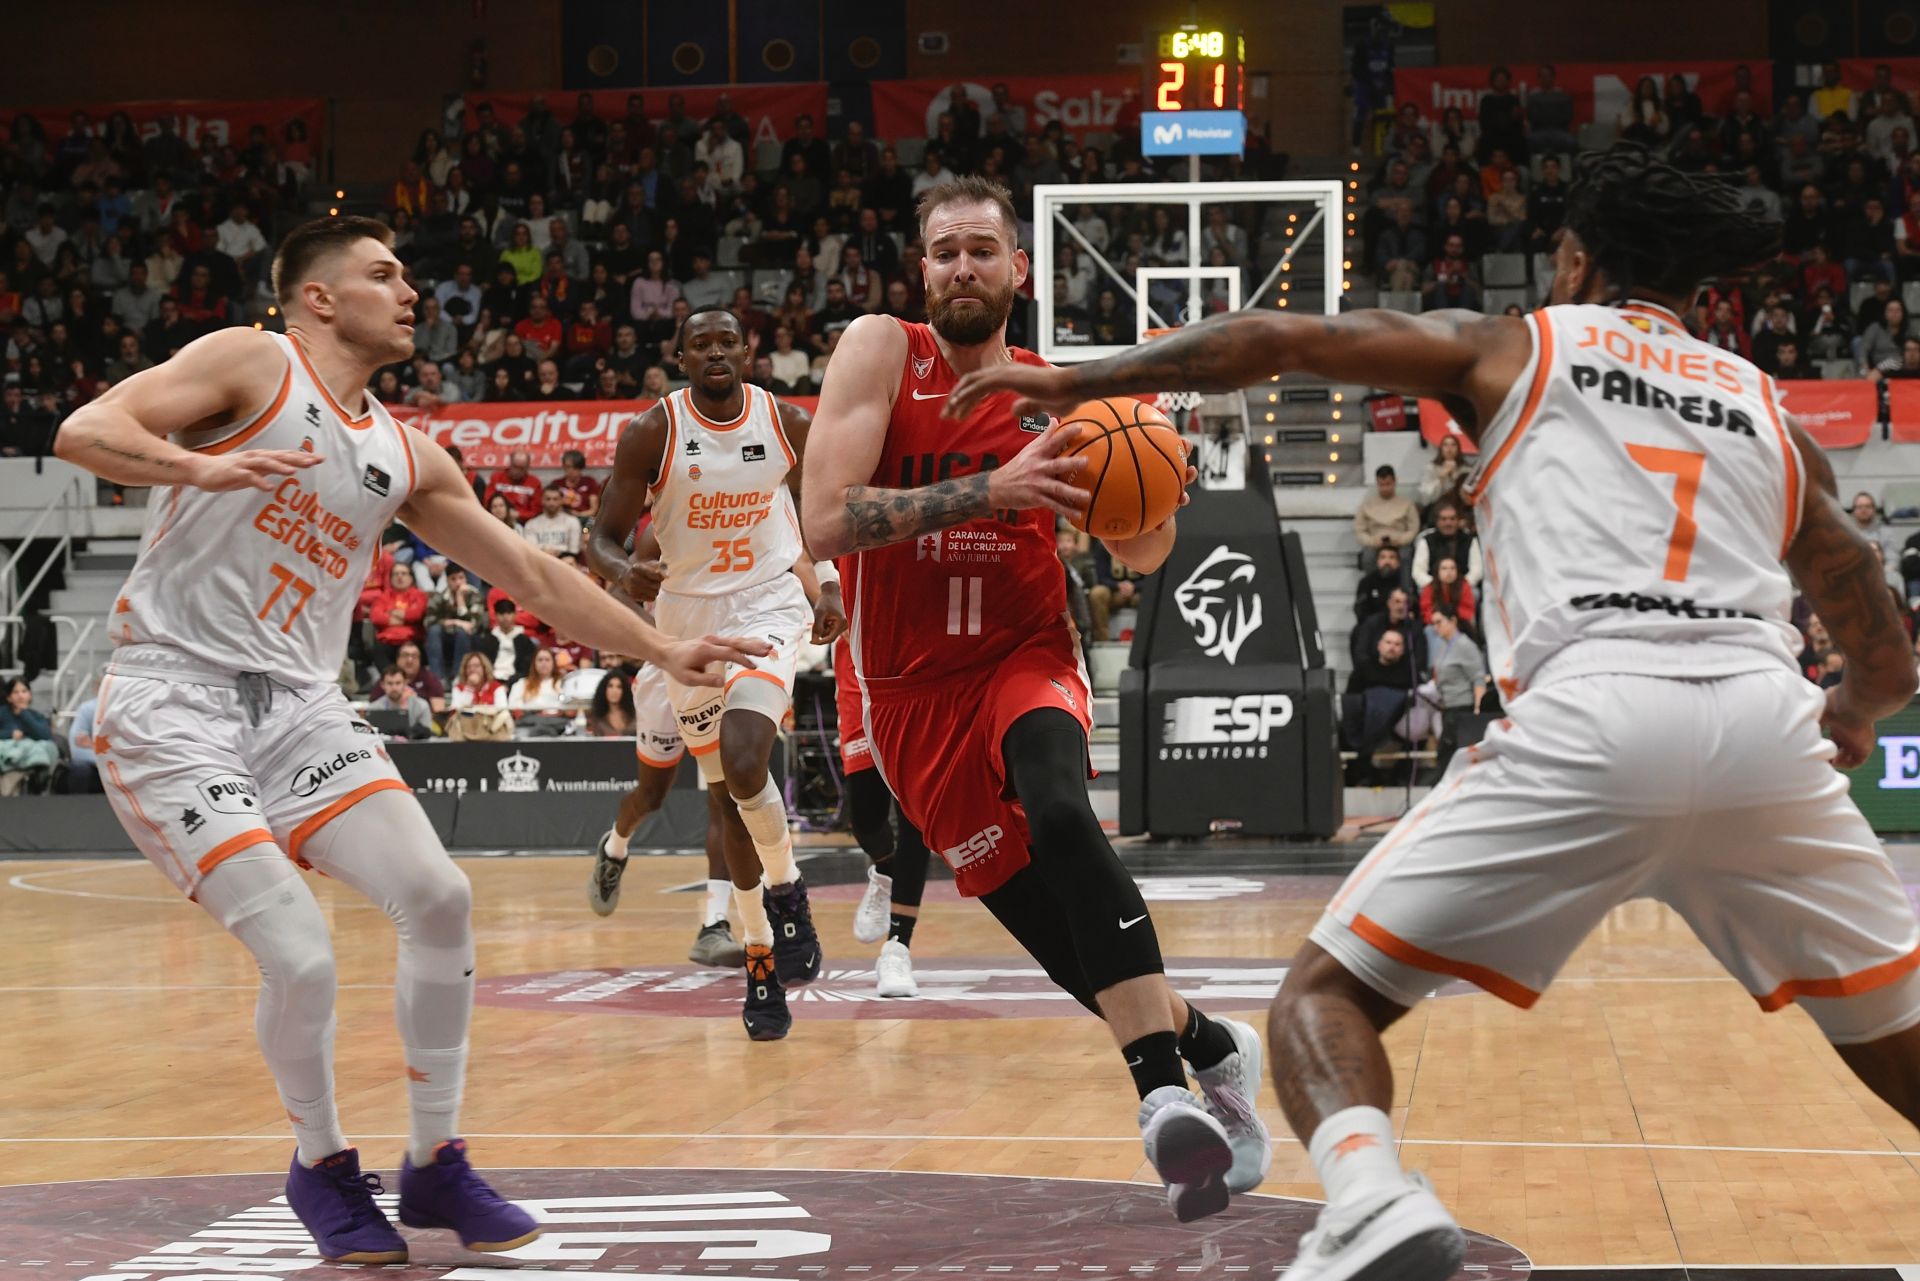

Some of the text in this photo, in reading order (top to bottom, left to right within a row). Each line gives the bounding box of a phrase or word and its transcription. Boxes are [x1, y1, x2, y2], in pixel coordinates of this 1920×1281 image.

[1172, 31, 1224, 58] 6:48
[1034, 88, 1124, 126] Salz
[1576, 325, 1744, 395] JONES
[425, 409, 638, 447] realtur
[274, 477, 354, 543] Cultura
[689, 491, 760, 511] Cultura
[1623, 441, 1707, 583] 7
[253, 503, 350, 580] Esfuerzo
[947, 541, 1017, 552] DE LA CRUZ 2024
[948, 530, 998, 540] CARAVACA
[709, 536, 755, 574] 35
[946, 551, 1001, 563] AÑO JUBILAR
[257, 561, 317, 635] 77
[946, 576, 983, 636] 11
[680, 704, 722, 726] PULEVA
[1163, 693, 1294, 745] ESP
[308, 749, 372, 791] Midea
[1158, 745, 1269, 761] SOLUTIONS
[942, 824, 1004, 869] ESP
